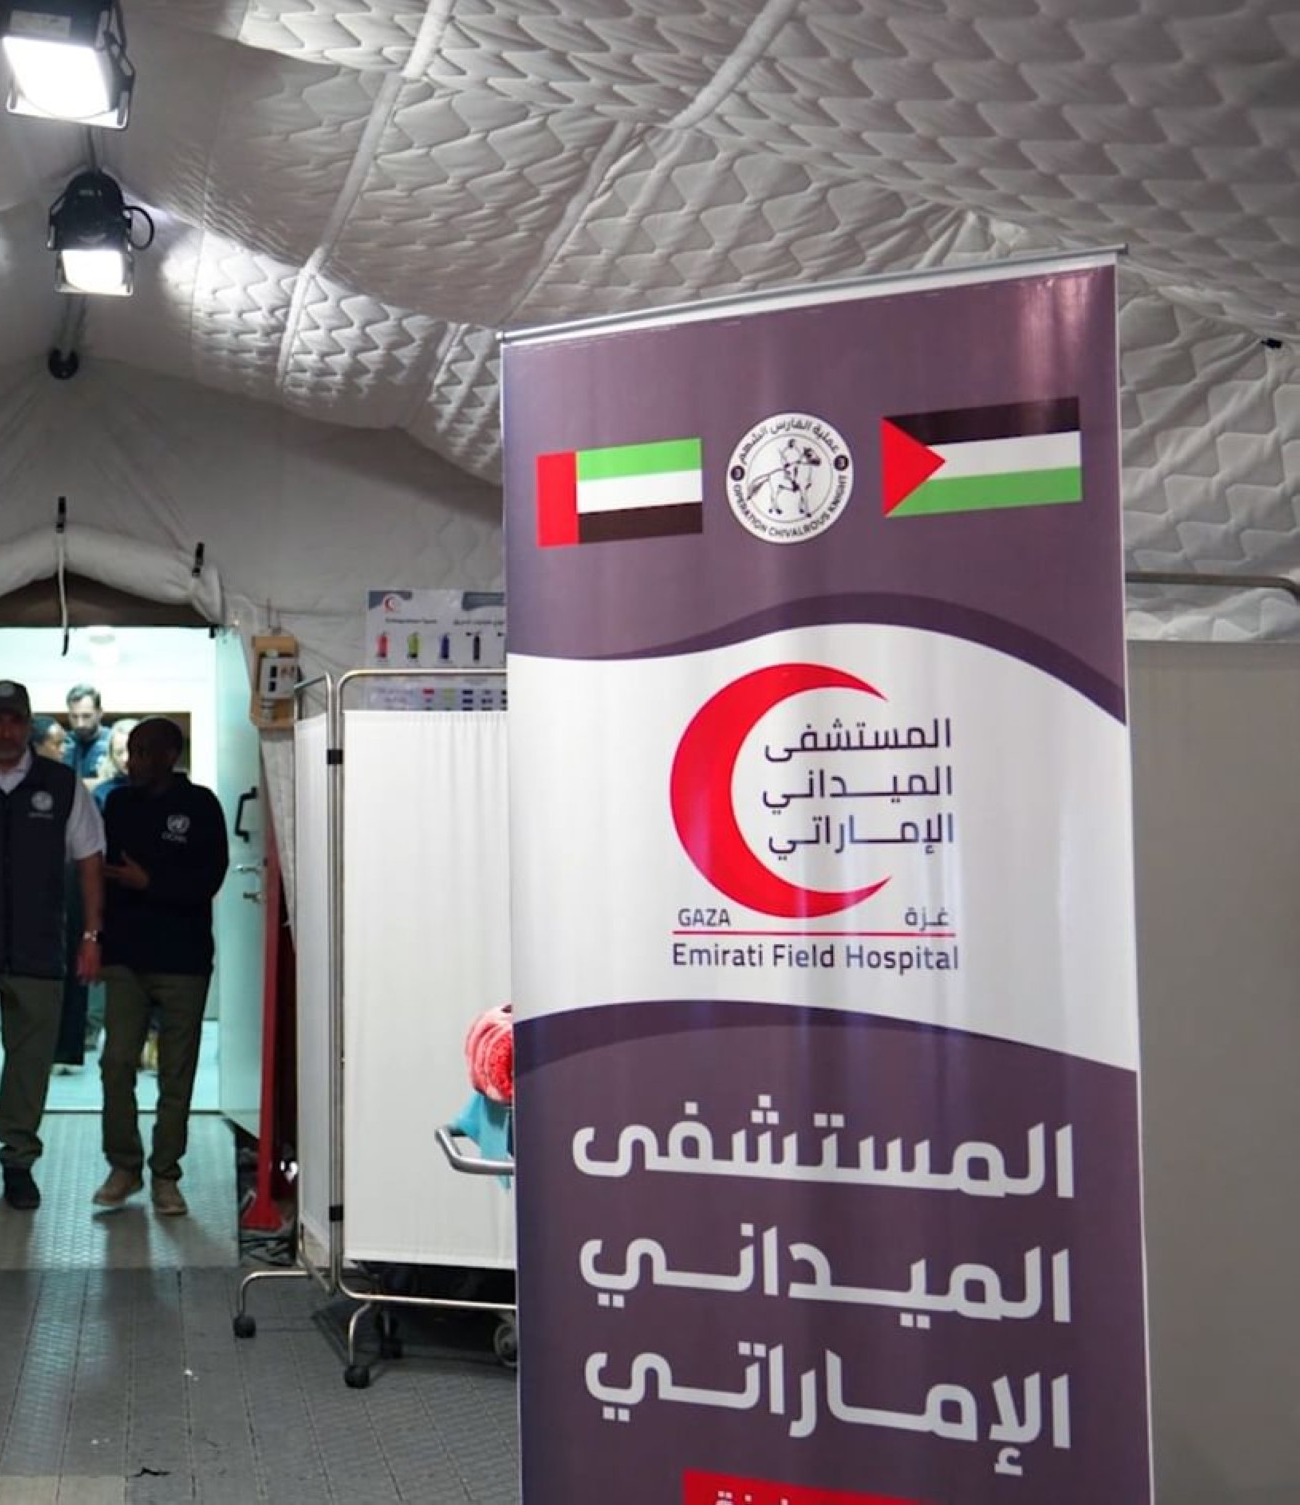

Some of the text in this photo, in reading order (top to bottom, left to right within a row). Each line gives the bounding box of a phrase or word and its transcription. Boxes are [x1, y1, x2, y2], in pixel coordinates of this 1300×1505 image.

[733, 484, 767, 532] OPERATION
[768, 511, 830, 538] CHIVALROUS
[765, 717, 951, 763] المستشفى
[763, 765, 952, 815] الميداني
[768, 813, 954, 861] الإماراتي
[678, 908, 731, 927] GAZA
[905, 907, 949, 931] غزة
[673, 943, 958, 976] Emirati Field Hospital
[572, 1094, 1074, 1198] المستشفى
[579, 1222, 1071, 1330] الميداني
[585, 1341, 1071, 1476] الإماراتي
